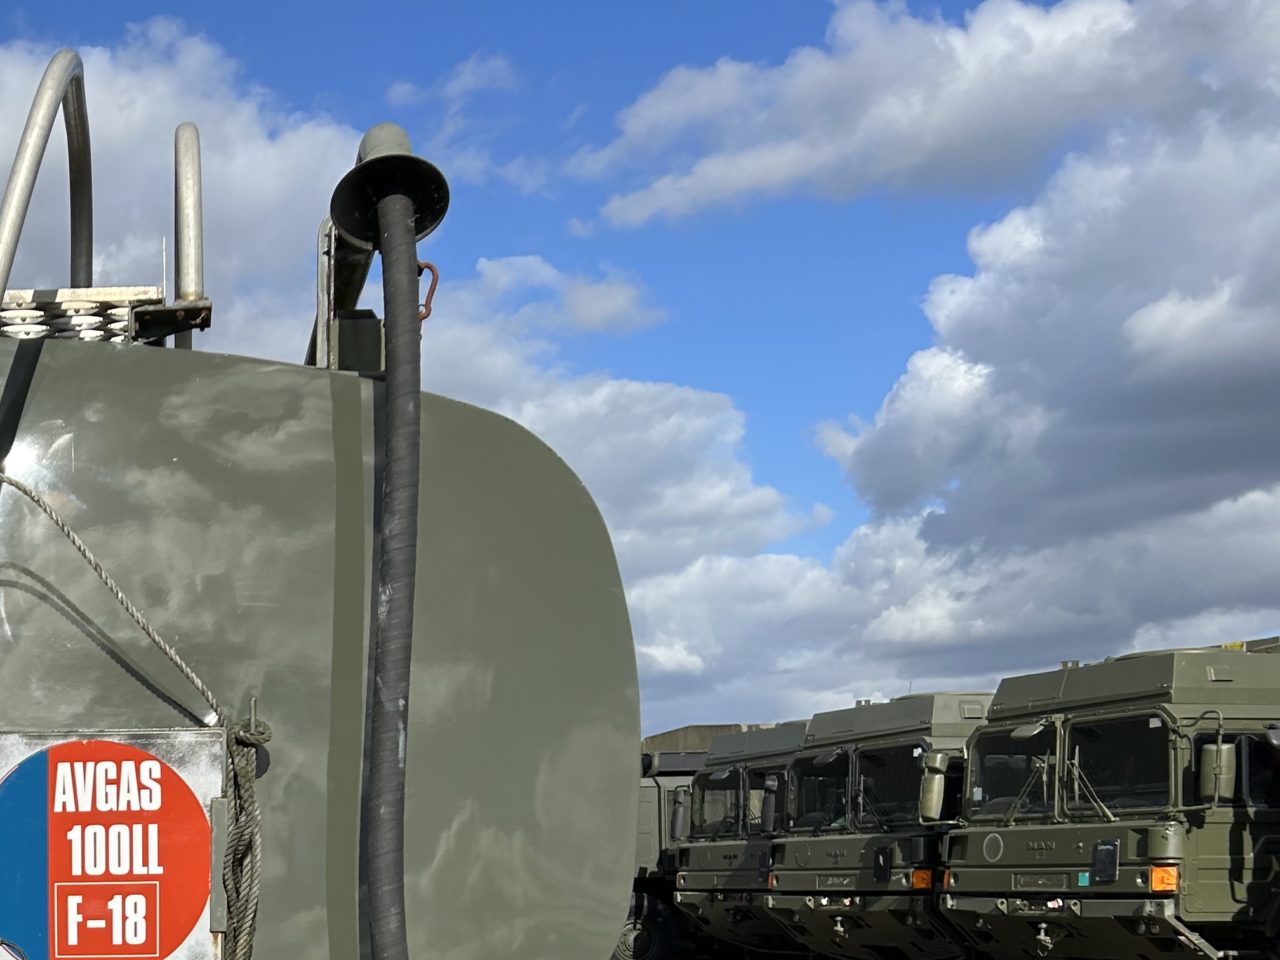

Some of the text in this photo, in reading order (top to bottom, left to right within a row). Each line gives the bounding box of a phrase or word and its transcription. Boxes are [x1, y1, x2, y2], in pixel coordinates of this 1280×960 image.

[53, 760, 162, 813] AVGAS
[66, 823, 164, 876] 100LL
[66, 893, 147, 946] F-18
